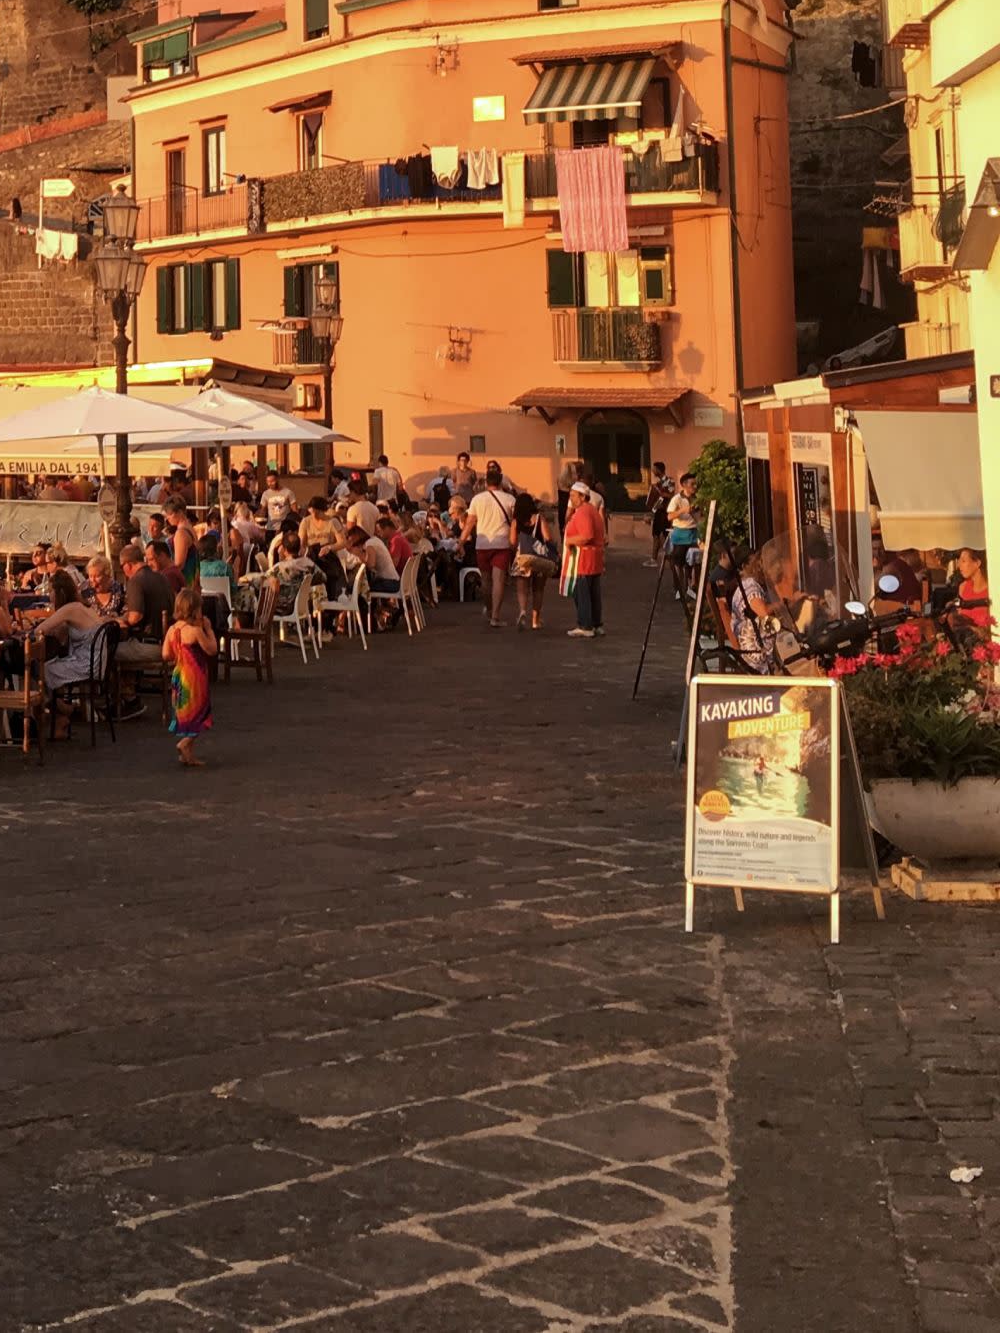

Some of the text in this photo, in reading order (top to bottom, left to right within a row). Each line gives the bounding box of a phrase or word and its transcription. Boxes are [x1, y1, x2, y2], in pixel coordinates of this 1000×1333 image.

[9, 462, 48, 473] EMILIA
[50, 463, 73, 474] DAL
[76, 462, 101, 474] 194
[701, 695, 773, 722] KAYAKING
[734, 713, 805, 737] ADVENTURE
[698, 827, 721, 836] Discover
[746, 831, 758, 839] wild
[780, 833, 791, 841] and
